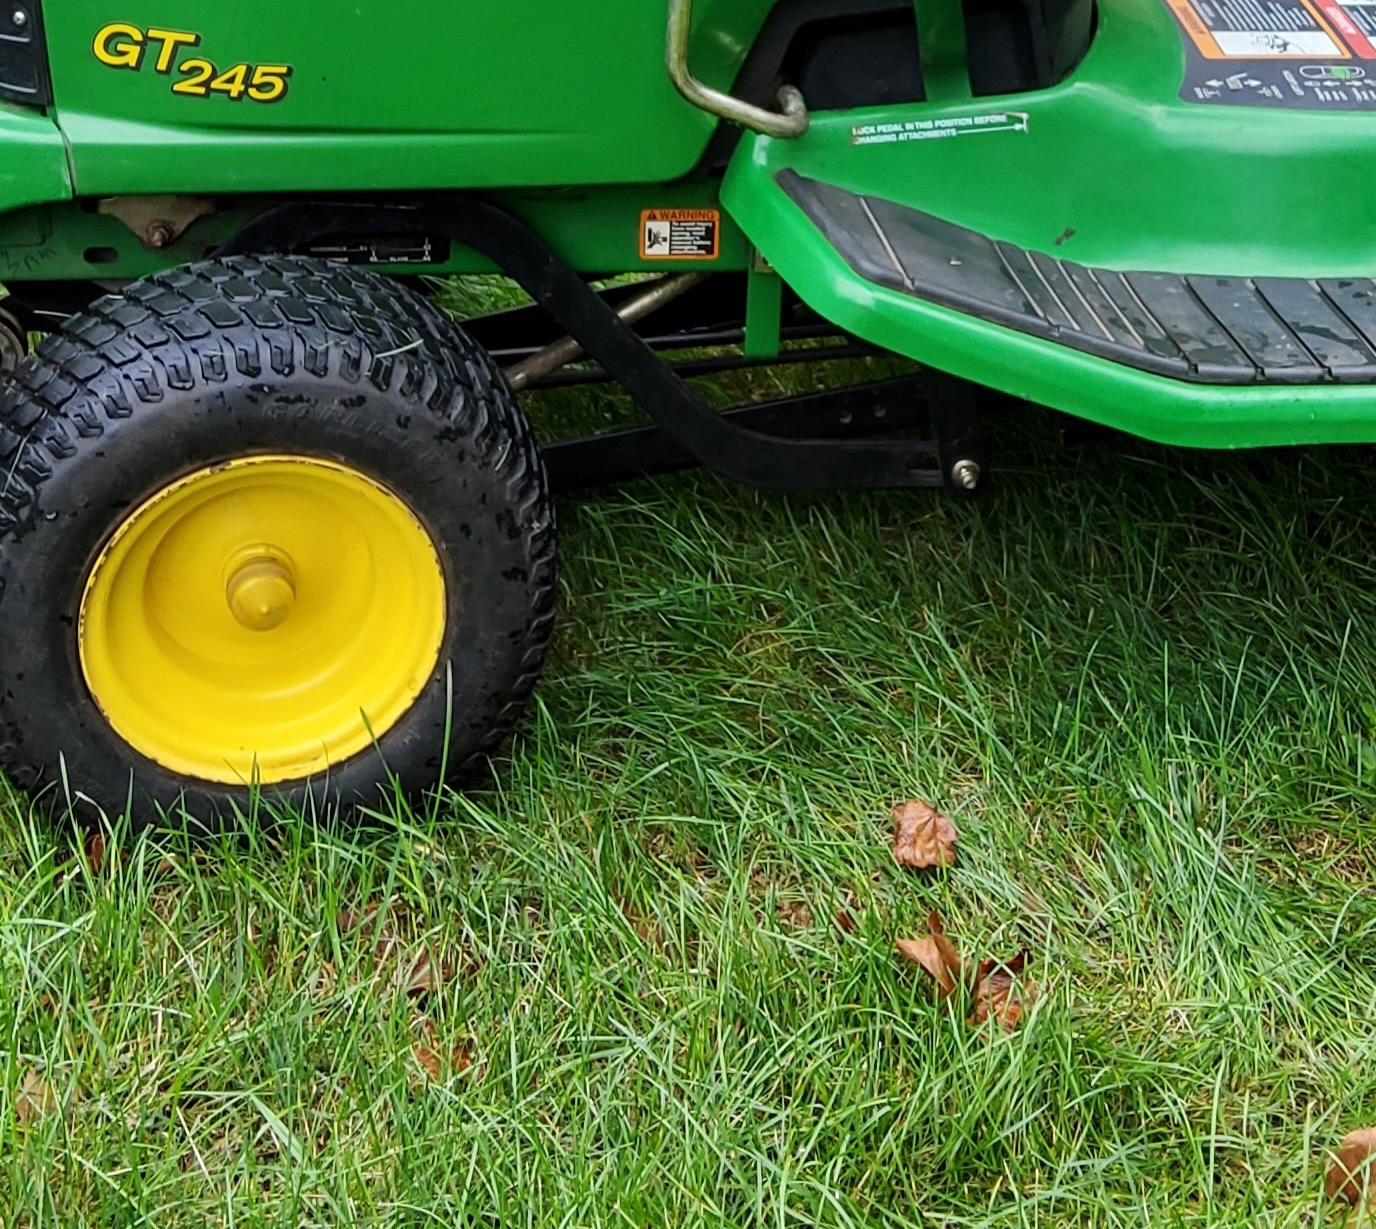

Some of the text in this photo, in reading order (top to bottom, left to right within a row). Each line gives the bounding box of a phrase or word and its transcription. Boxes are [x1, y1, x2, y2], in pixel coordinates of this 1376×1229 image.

[92, 22, 293, 103] GT 245
[876, 123, 904, 133] PEDAL
[905, 122, 914, 131] IN
[914, 120, 933, 130] THIS
[934, 117, 973, 128] POSITION
[973, 114, 1007, 125] BEFORE
[898, 128, 957, 141] ATTACHMENTS
[660, 211, 714, 220] WARNING
